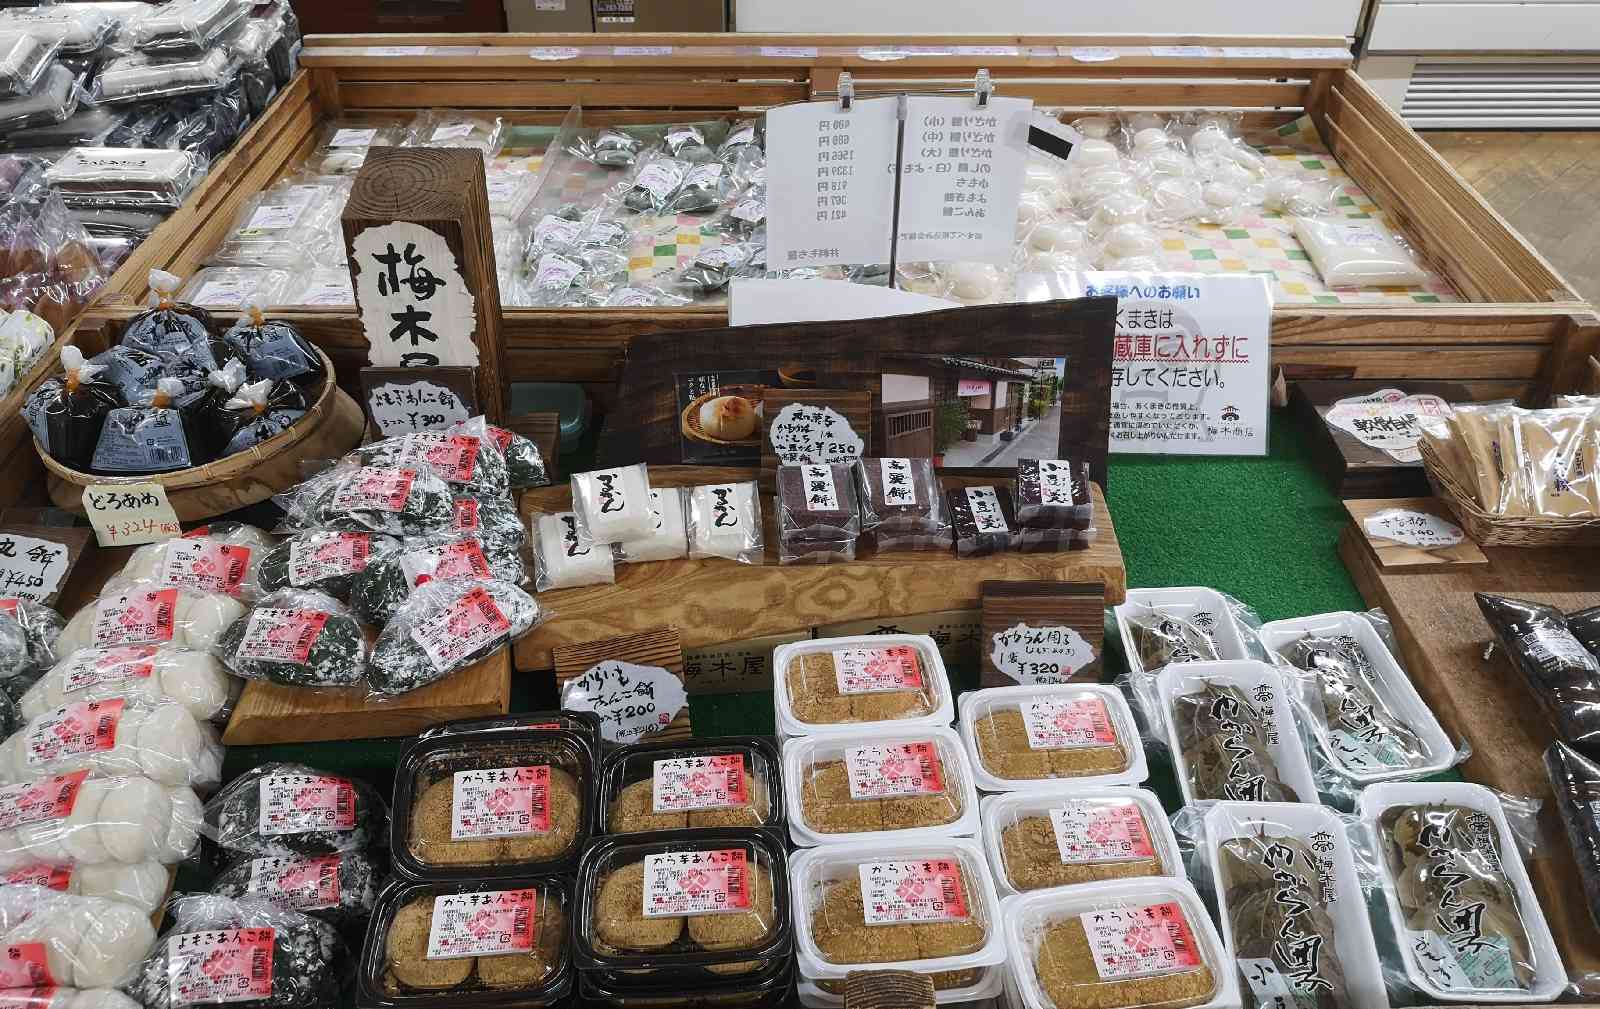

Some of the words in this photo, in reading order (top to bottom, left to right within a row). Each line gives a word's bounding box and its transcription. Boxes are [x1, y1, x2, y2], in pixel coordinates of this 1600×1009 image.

[1115, 308, 1174, 329] くまきは
[1113, 334, 1249, 360] 蔵庫に入れずに
[1111, 368, 1225, 389] 存してください。
[88, 492, 160, 511] どろあめ
[660, 757, 741, 770] から芋あんこ餅
[462, 768, 549, 785] から芋あんこ餅
[653, 851, 744, 865] から芋あんこ餅
[871, 861, 951, 874] からいも餅
[443, 891, 534, 907] から芋あんこ餅
[1093, 905, 1174, 924] からいも餅
